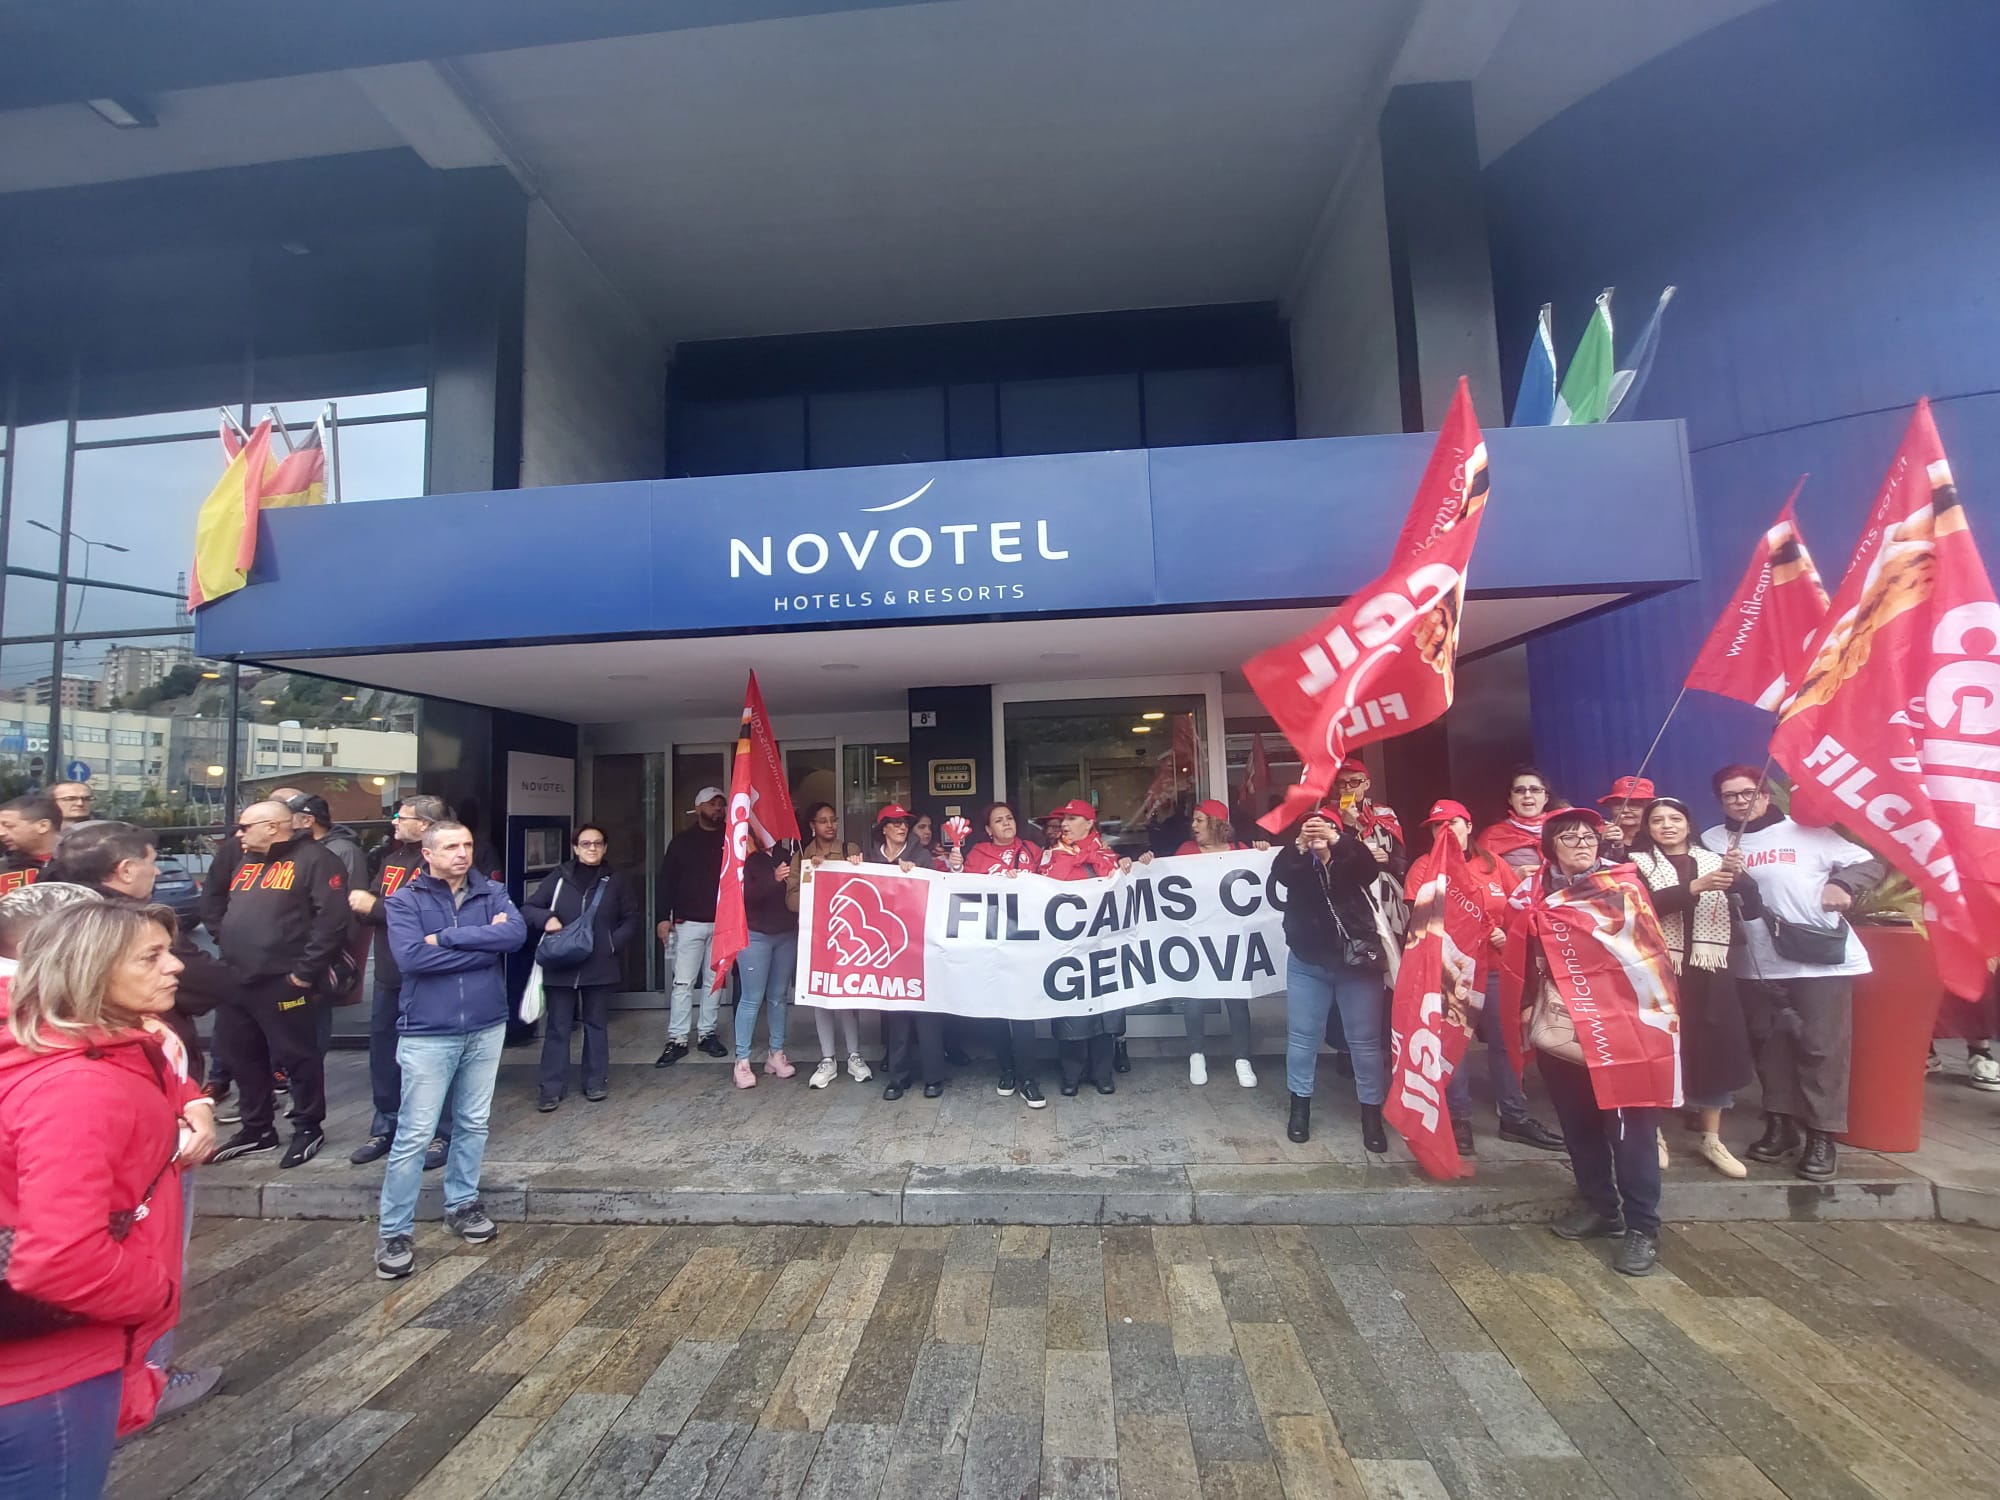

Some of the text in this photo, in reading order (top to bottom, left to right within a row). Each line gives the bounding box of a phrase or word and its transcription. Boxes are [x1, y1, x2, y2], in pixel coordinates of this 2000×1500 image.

[730, 518, 1069, 578] NOVOTEL
[774, 584, 1025, 612] HOTELS & RESORTS
[521, 781, 567, 792] NOVOTEL
[1747, 848, 1777, 868] AMS
[945, 874, 1198, 942] FILCAMS
[1042, 930, 1277, 1002] GENOVA
[810, 970, 924, 998] FILCAMS
